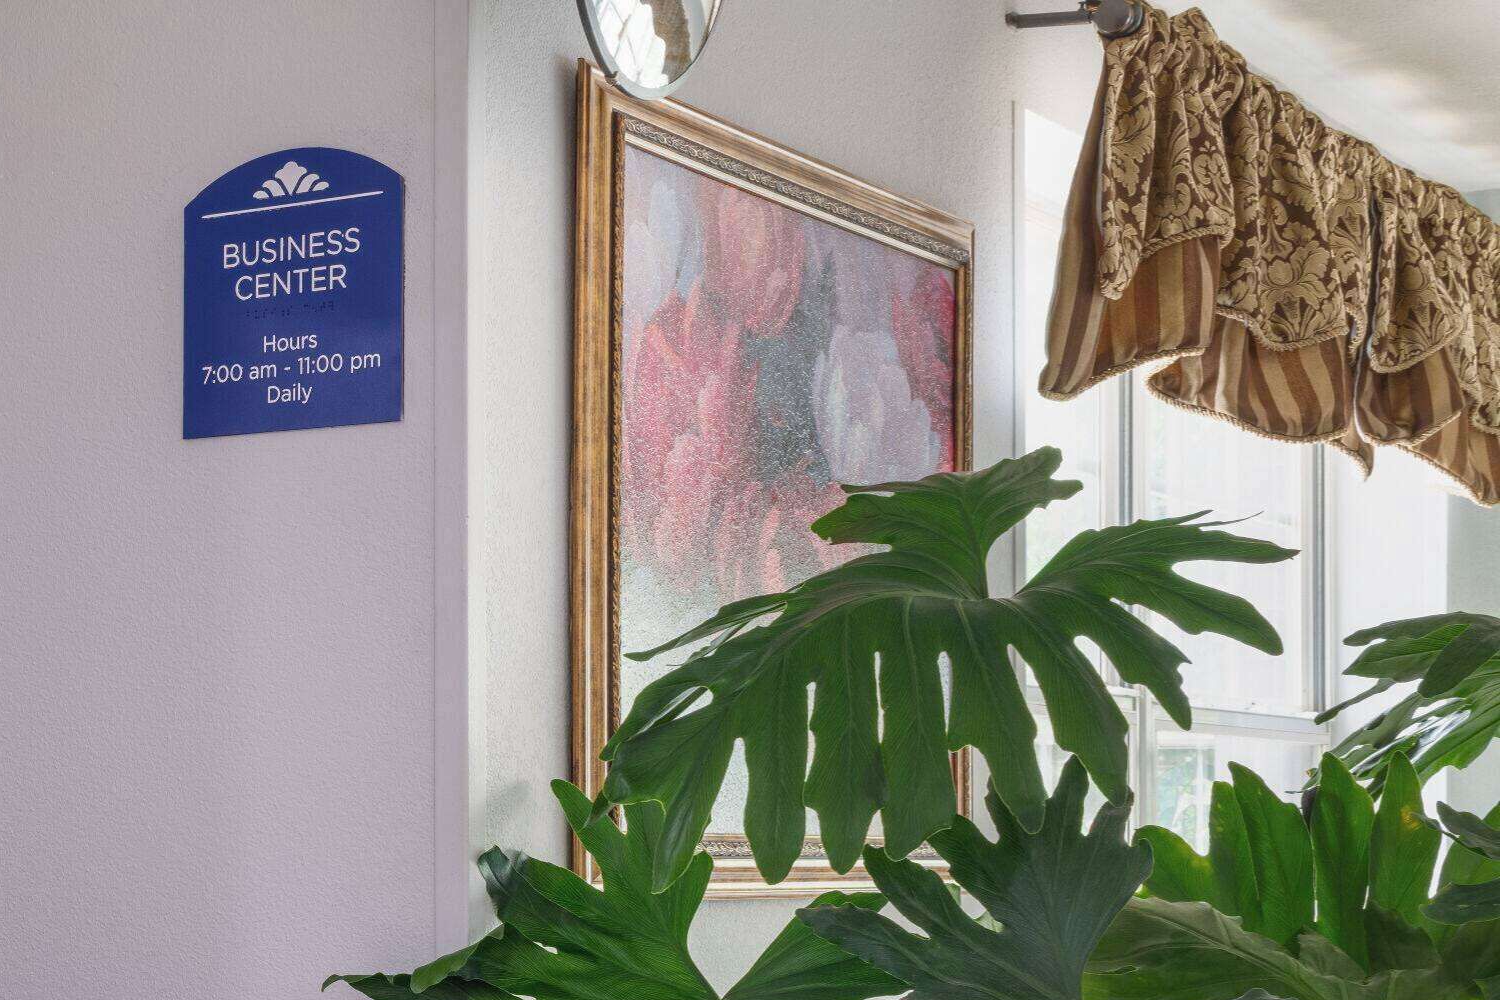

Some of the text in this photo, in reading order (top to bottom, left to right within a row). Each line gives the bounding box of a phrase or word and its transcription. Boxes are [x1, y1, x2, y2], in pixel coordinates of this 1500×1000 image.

[223, 227, 361, 269] BUSINESS
[235, 264, 347, 301] CENTER
[263, 333, 318, 353] Hours
[202, 364, 243, 385] 7:00
[249, 361, 277, 380] am
[297, 353, 343, 375] 11:00
[350, 352, 381, 373] pm
[267, 383, 313, 404] Daily
